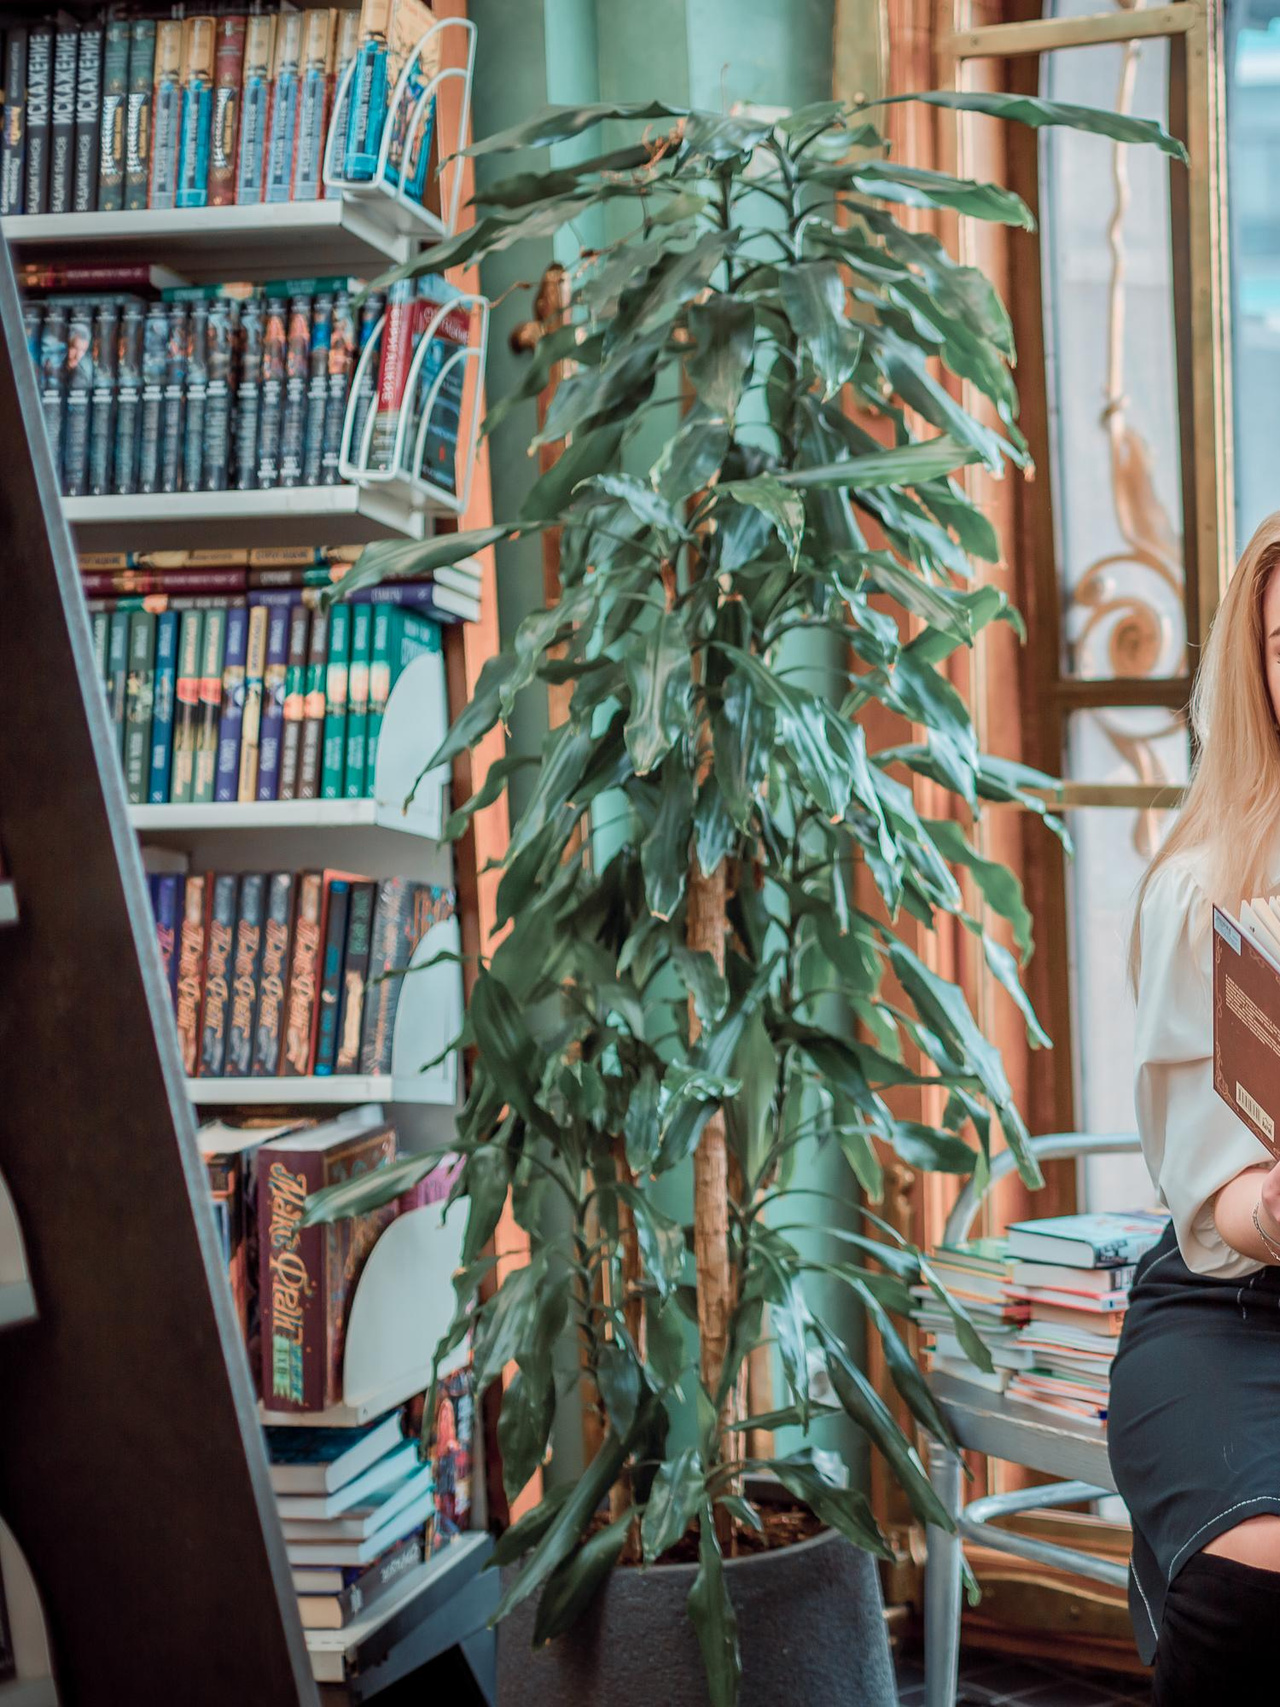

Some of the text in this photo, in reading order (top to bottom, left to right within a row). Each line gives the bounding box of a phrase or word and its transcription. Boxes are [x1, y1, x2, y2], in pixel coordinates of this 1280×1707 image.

[27, 34, 49, 127] ИСКАЖЕНИЕ
[52, 33, 76, 126] ИСКАЖЕНИЕ
[76, 31, 100, 123] ИСКАЖЕНИЕ
[268, 1162, 314, 1346] Макс Фрай
